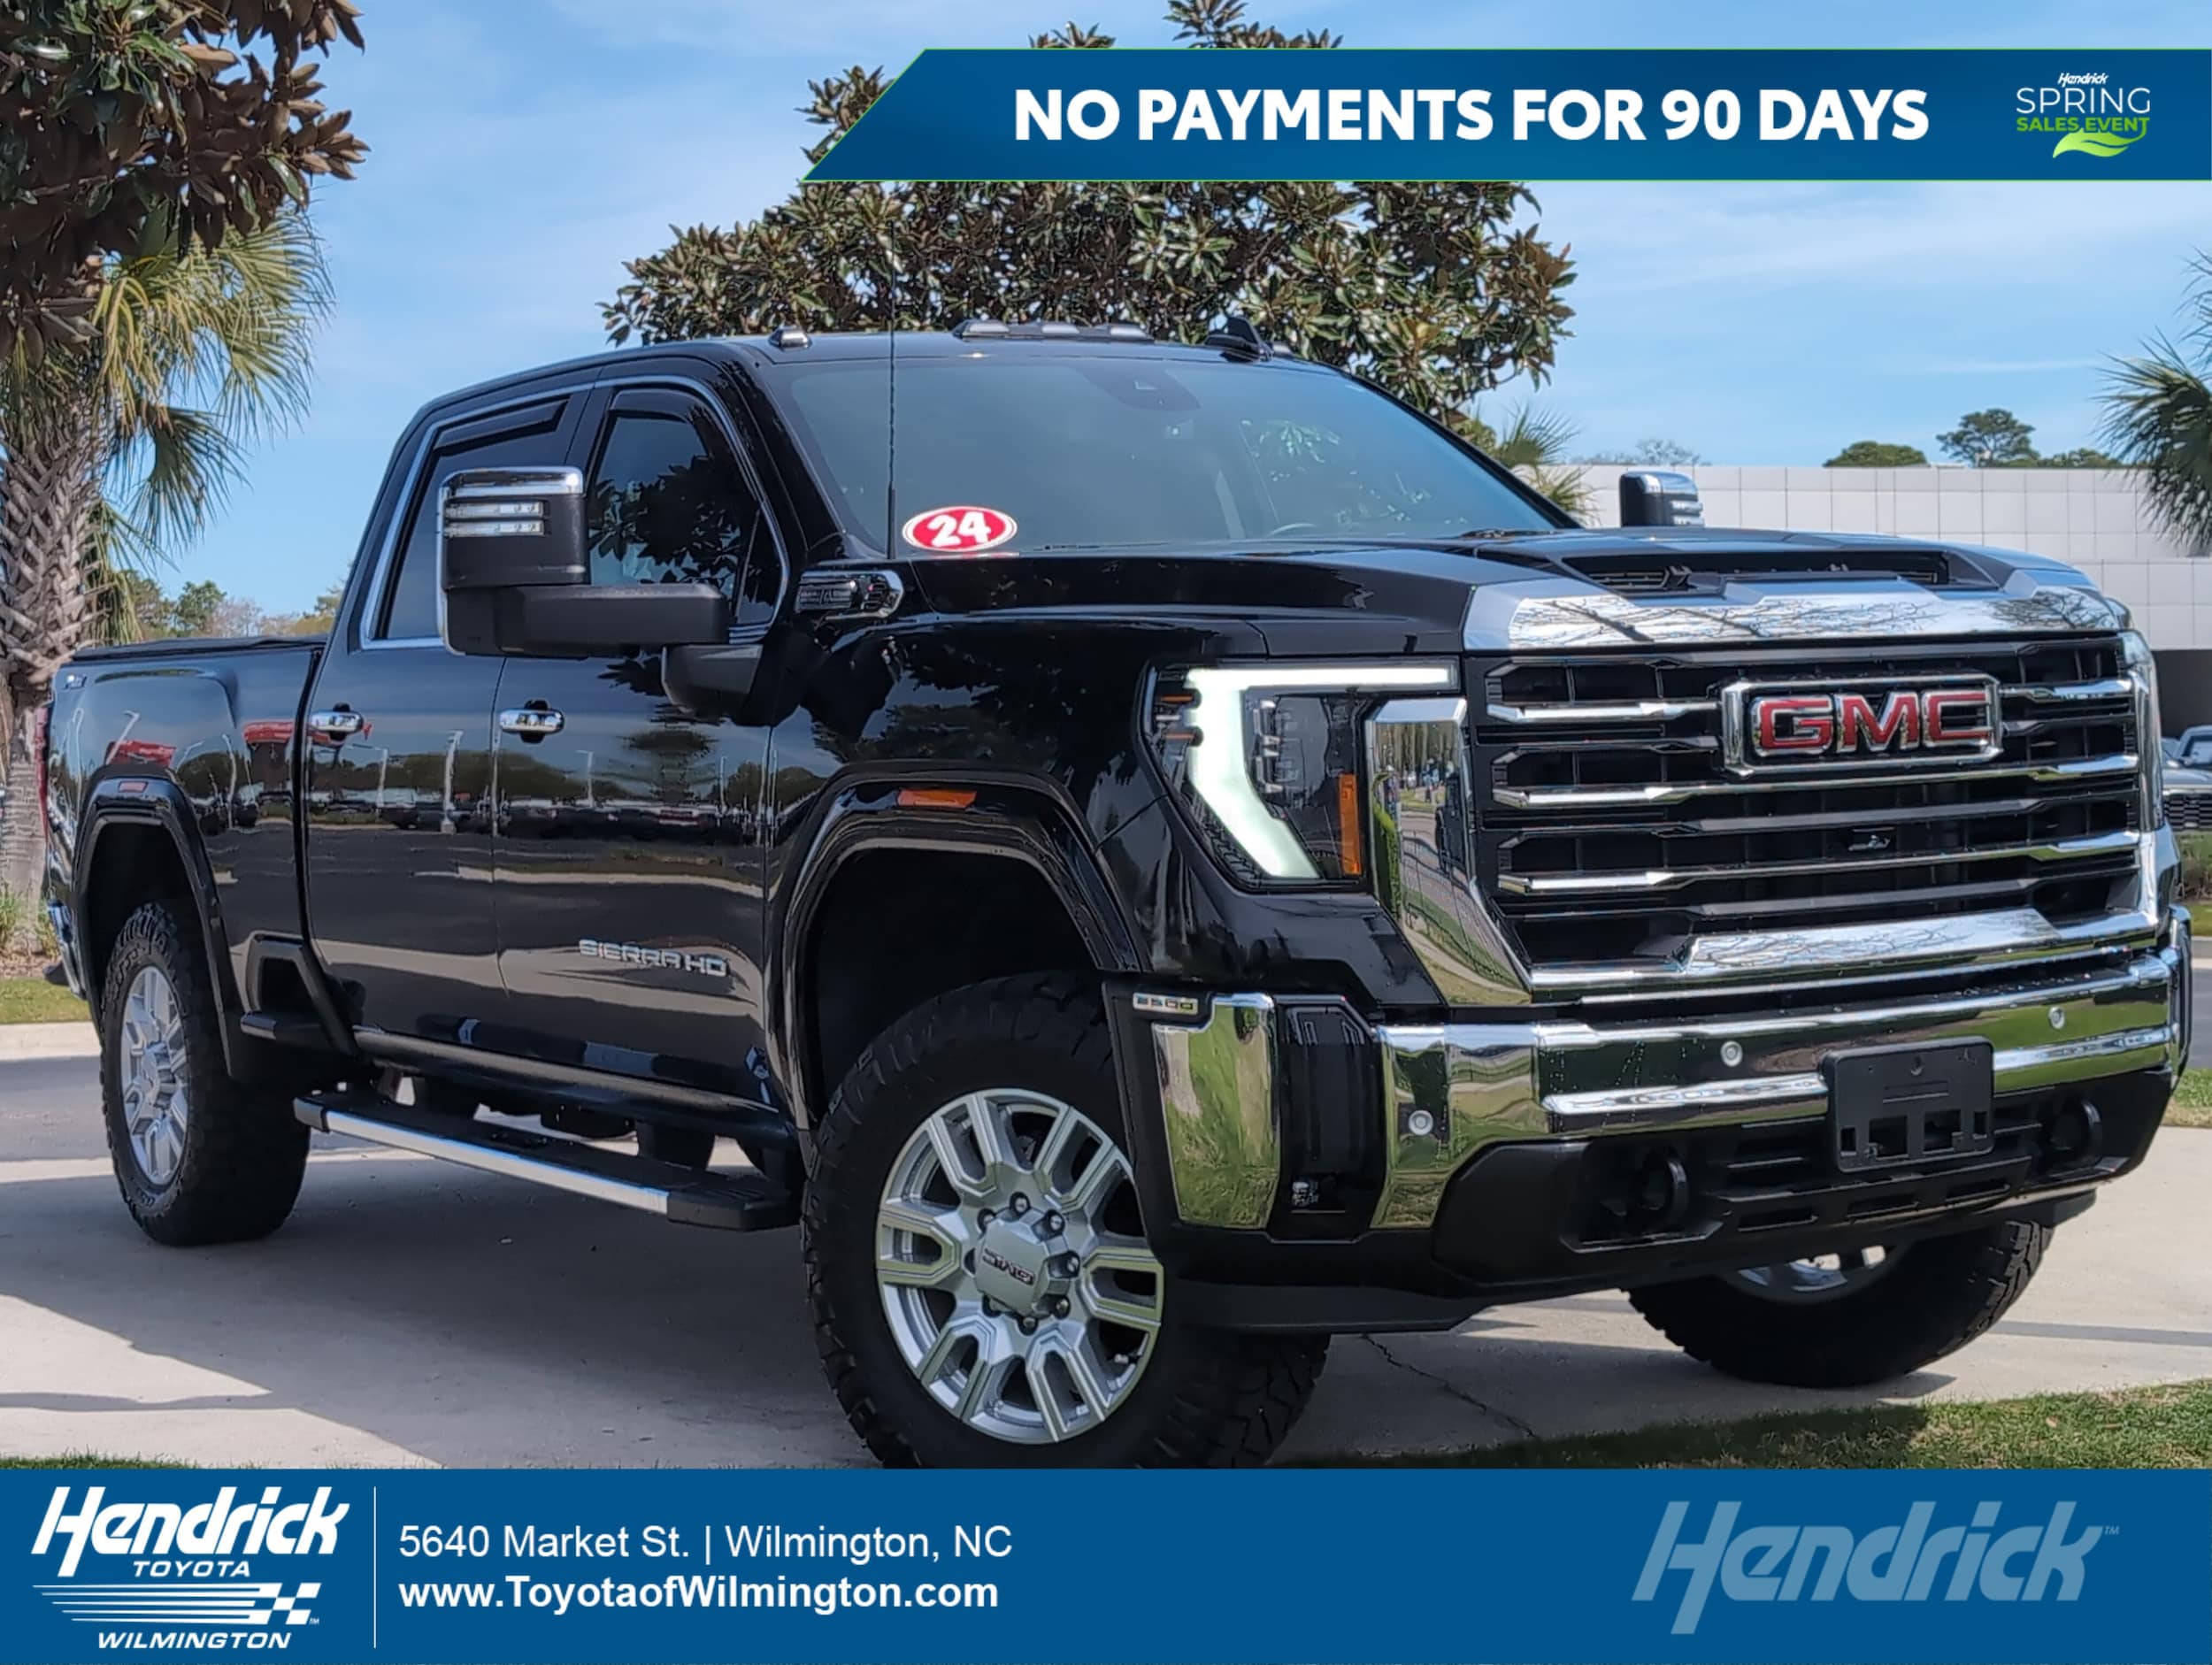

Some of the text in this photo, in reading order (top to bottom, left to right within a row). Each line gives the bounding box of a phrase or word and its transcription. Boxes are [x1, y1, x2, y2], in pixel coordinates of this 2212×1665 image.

[926, 510, 992, 548] 24
[1753, 689, 1994, 757] GMC
[579, 938, 727, 977] SIERRA HD
[981, 1247, 1036, 1286] GMC
